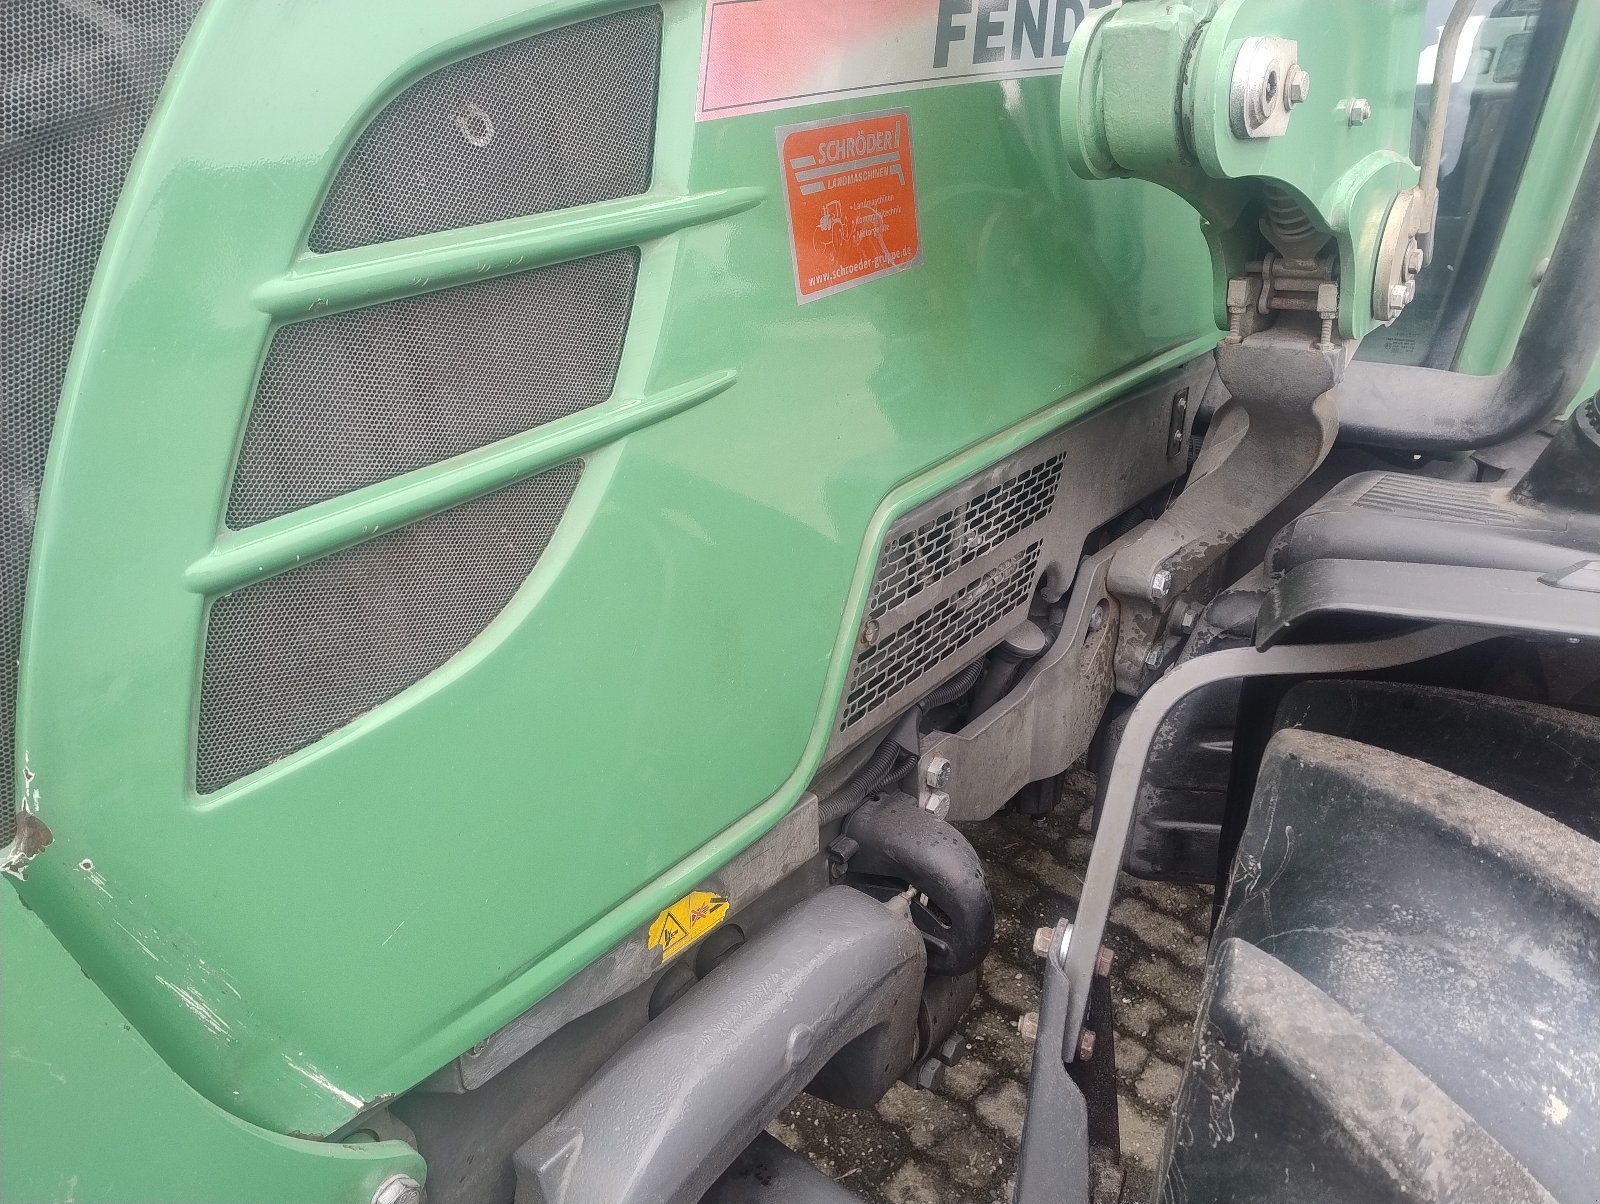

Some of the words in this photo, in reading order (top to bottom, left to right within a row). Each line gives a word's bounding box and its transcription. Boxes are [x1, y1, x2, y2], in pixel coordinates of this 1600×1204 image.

[933, 0, 1112, 68] FEND
[818, 130, 893, 164] SCHRÖDER
[827, 166, 889, 190] LANDMASCHINEN
[808, 245, 911, 287] www.schroeder-gruppe.de
